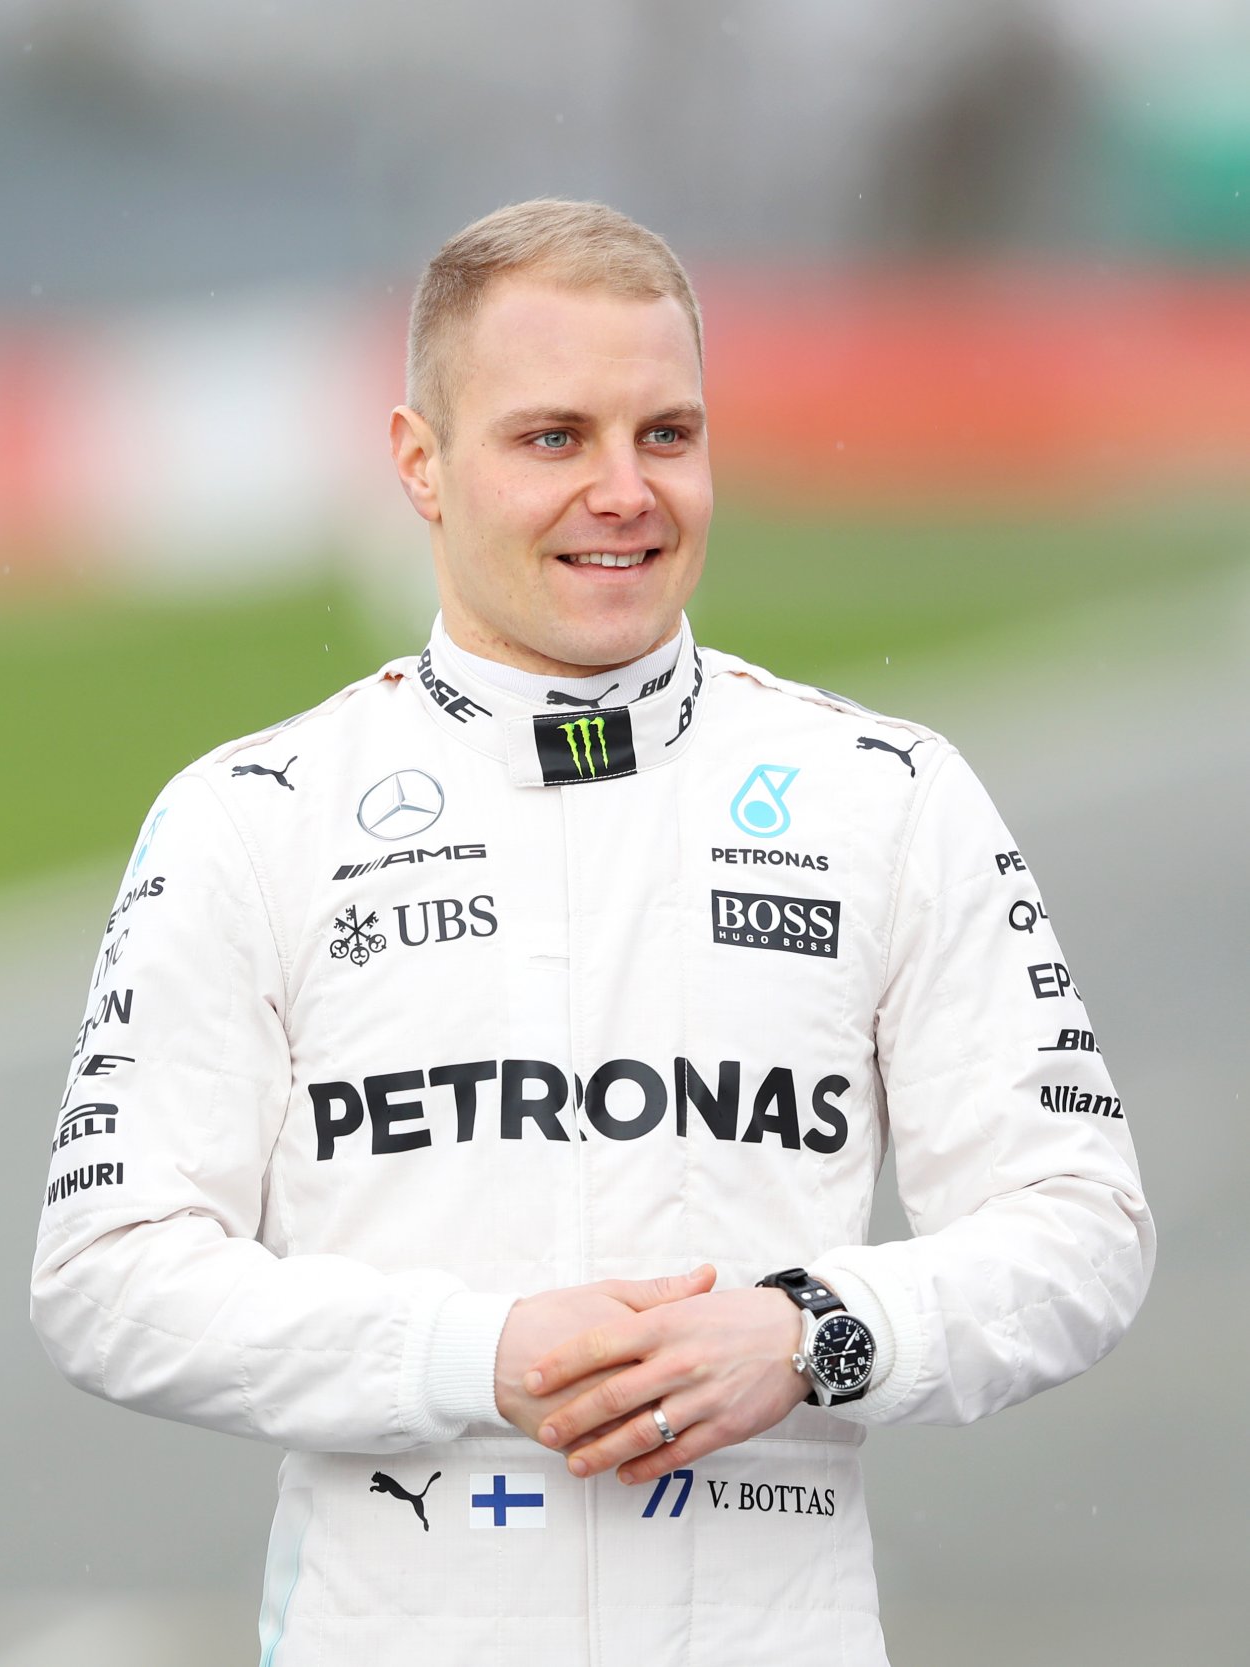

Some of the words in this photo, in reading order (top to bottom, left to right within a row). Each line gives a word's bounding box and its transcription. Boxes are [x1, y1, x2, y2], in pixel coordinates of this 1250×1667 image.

[417, 648, 493, 724] BOSE
[381, 844, 486, 867] AMG
[711, 847, 829, 871] PETRONAS
[393, 895, 498, 947] UBS
[716, 896, 834, 940] BOSS
[719, 931, 769, 944] HUGO
[783, 938, 831, 952] BOSS
[1027, 962, 1083, 1001] EP
[1038, 1029, 1103, 1054] BO
[307, 1056, 851, 1161] PETRONAS
[47, 1162, 124, 1206] WIHURI
[707, 1480, 730, 1509] V.
[739, 1482, 836, 1517] BOTTAS
